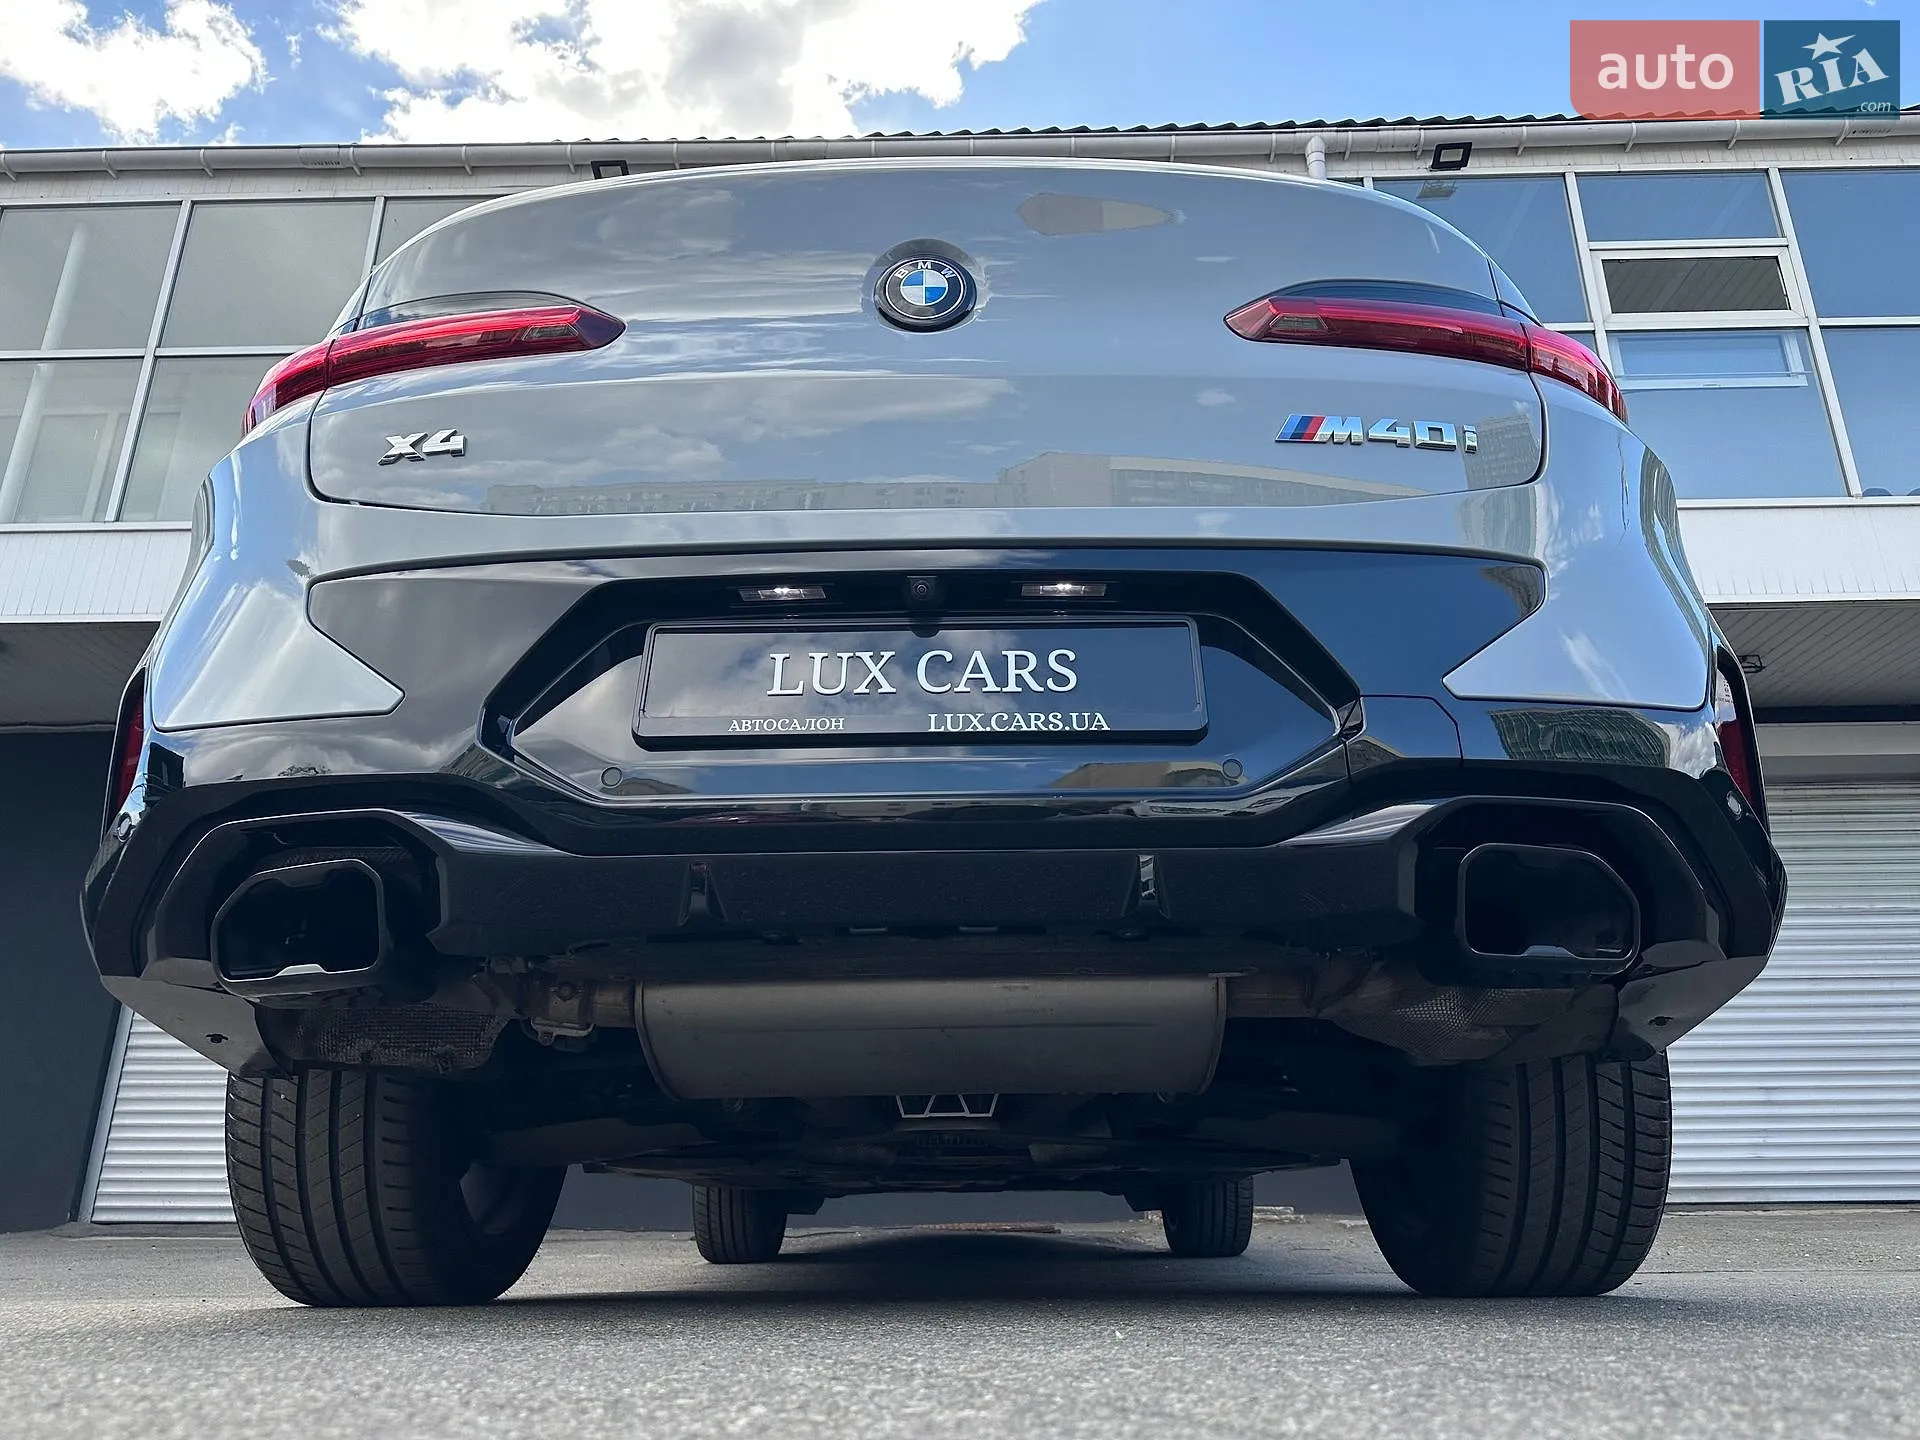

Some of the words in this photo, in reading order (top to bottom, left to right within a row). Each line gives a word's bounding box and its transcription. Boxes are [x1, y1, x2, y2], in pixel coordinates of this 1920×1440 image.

[894, 260, 957, 279] BMW
[377, 428, 468, 466] X4
[1310, 415, 1479, 454] M40i
[766, 650, 898, 697] LUX
[915, 648, 1079, 694] CARS
[727, 716, 846, 733] АВТОСАЛОН
[927, 711, 1111, 733] LUX.CARS.UA
